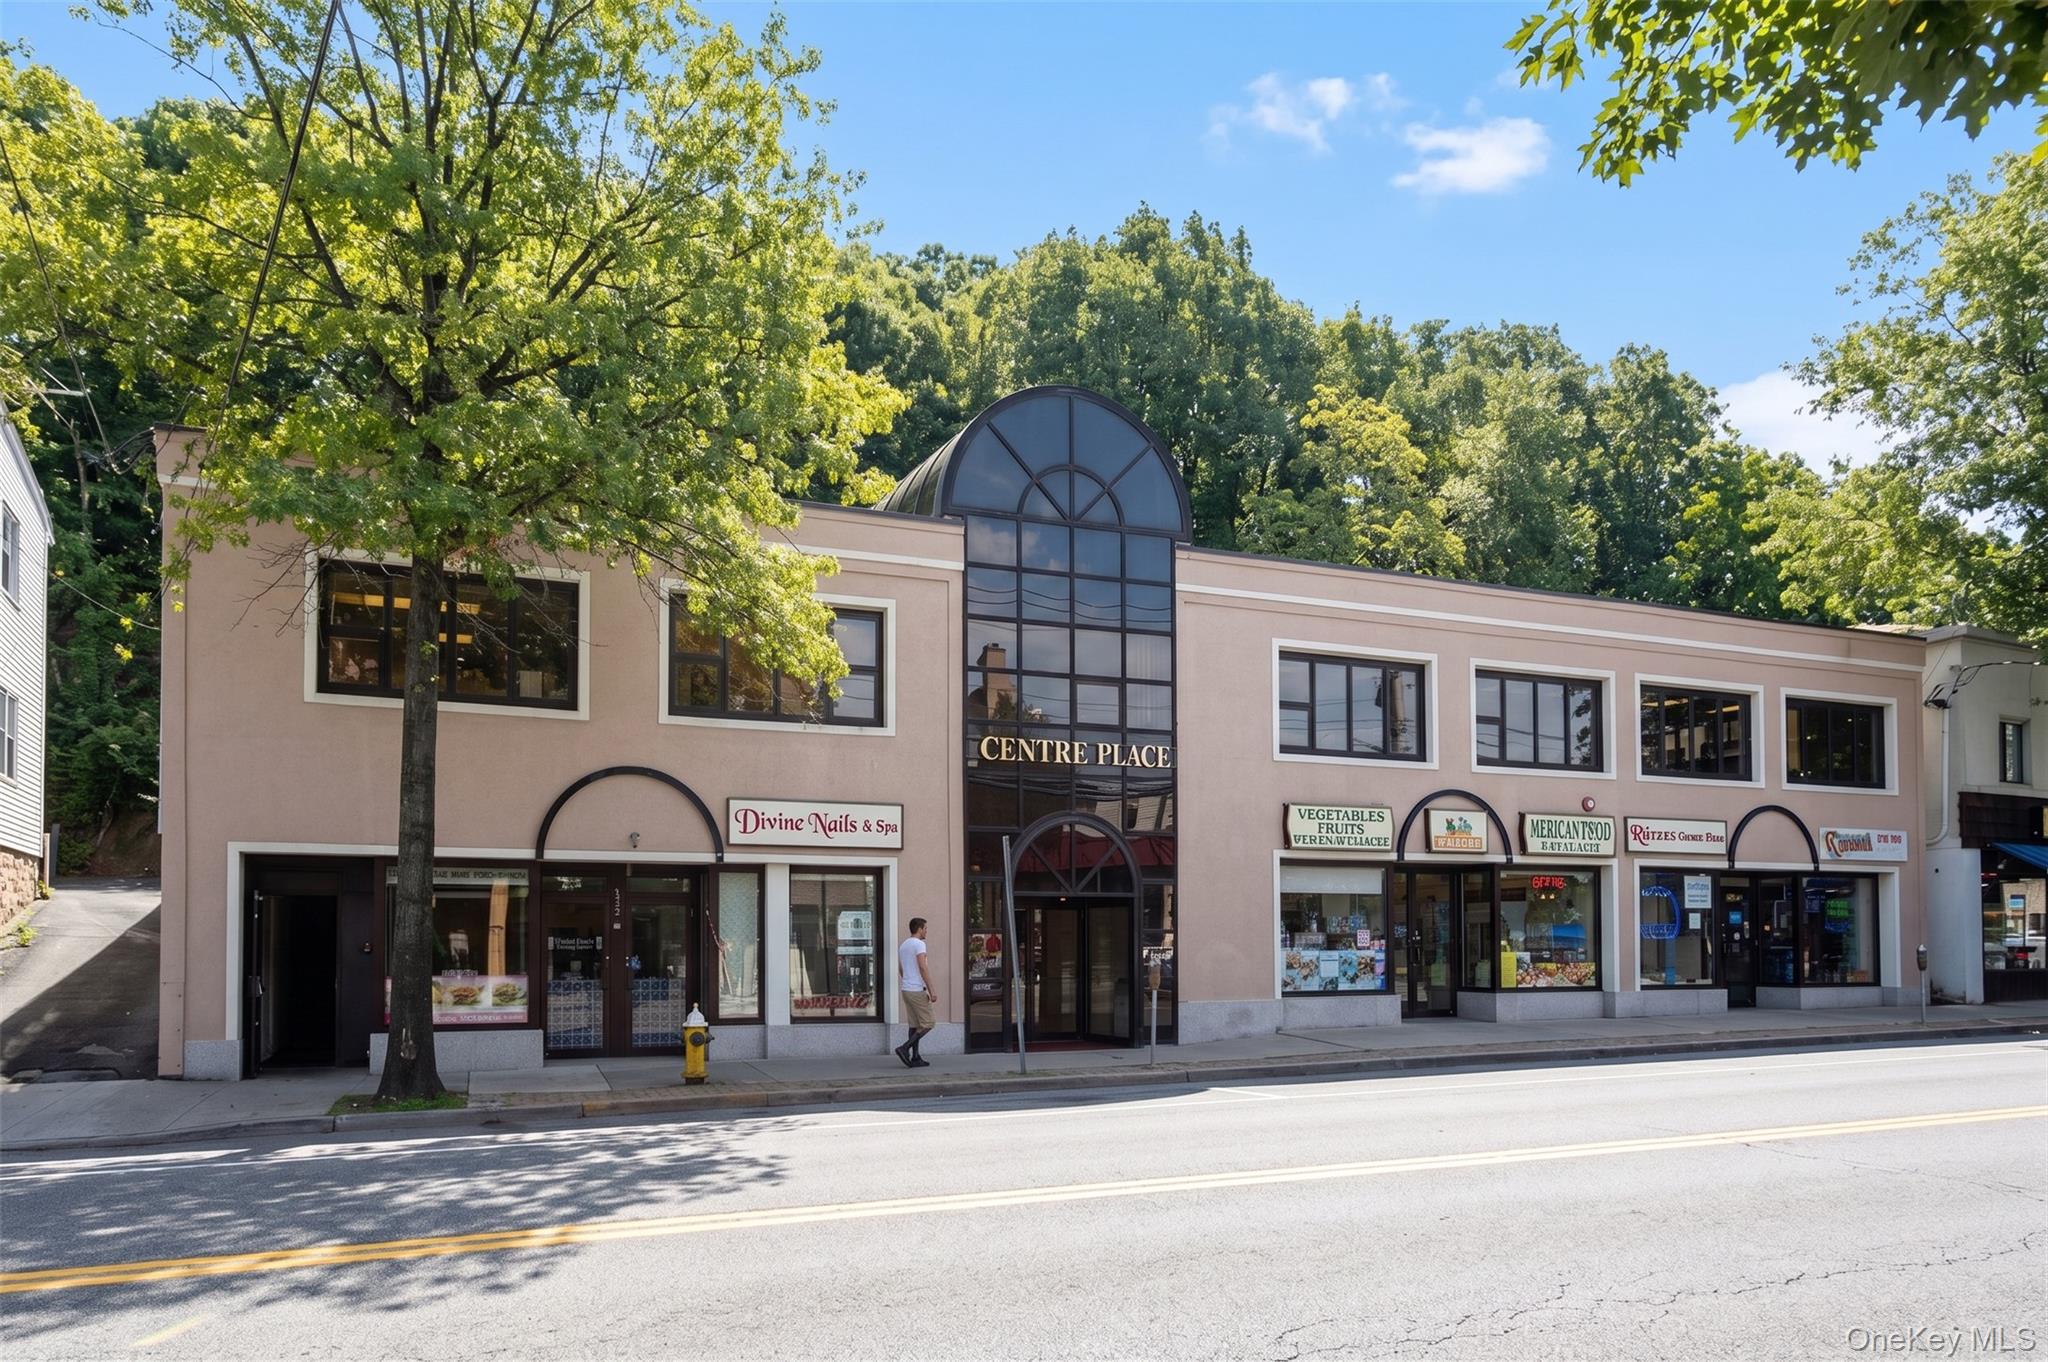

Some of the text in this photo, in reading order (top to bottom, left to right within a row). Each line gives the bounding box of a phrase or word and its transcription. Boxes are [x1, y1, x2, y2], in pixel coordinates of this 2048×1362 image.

[980, 735, 1172, 768] CENTRE PLACE
[734, 808, 899, 839] Divine Nails & Spa
[1298, 808, 1385, 823] VEGETABLES
[1317, 822, 1365, 835] FRUITS
